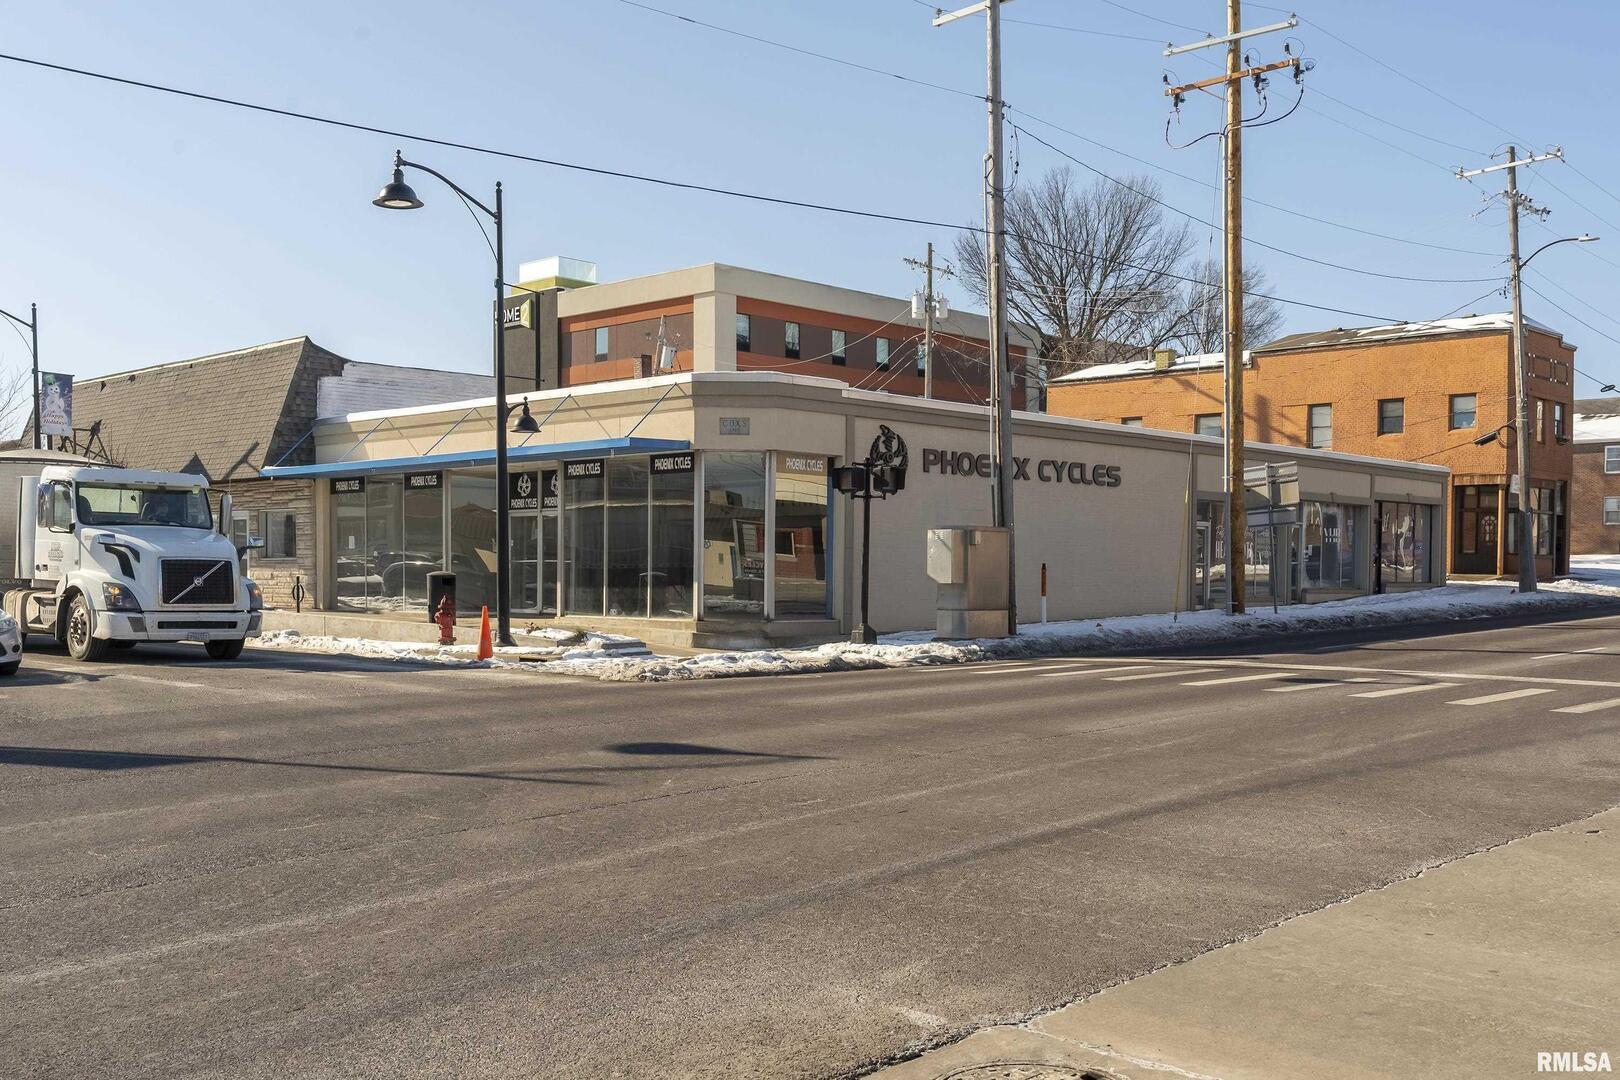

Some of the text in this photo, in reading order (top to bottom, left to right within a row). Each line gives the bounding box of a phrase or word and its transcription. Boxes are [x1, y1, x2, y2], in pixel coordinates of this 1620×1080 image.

[568, 462, 601, 476] PHOENIX CYCLES
[654, 456, 692, 470] PHOENIX CYCLES
[785, 458, 823, 471] PHOENIX CYCLES
[922, 448, 1122, 487] PHOEX CYCLES
[411, 475, 436, 487] PHOENIX CYCLES
[511, 498, 537, 508] PHOENIX CYCLES
[544, 497, 558, 507] PHOEN
